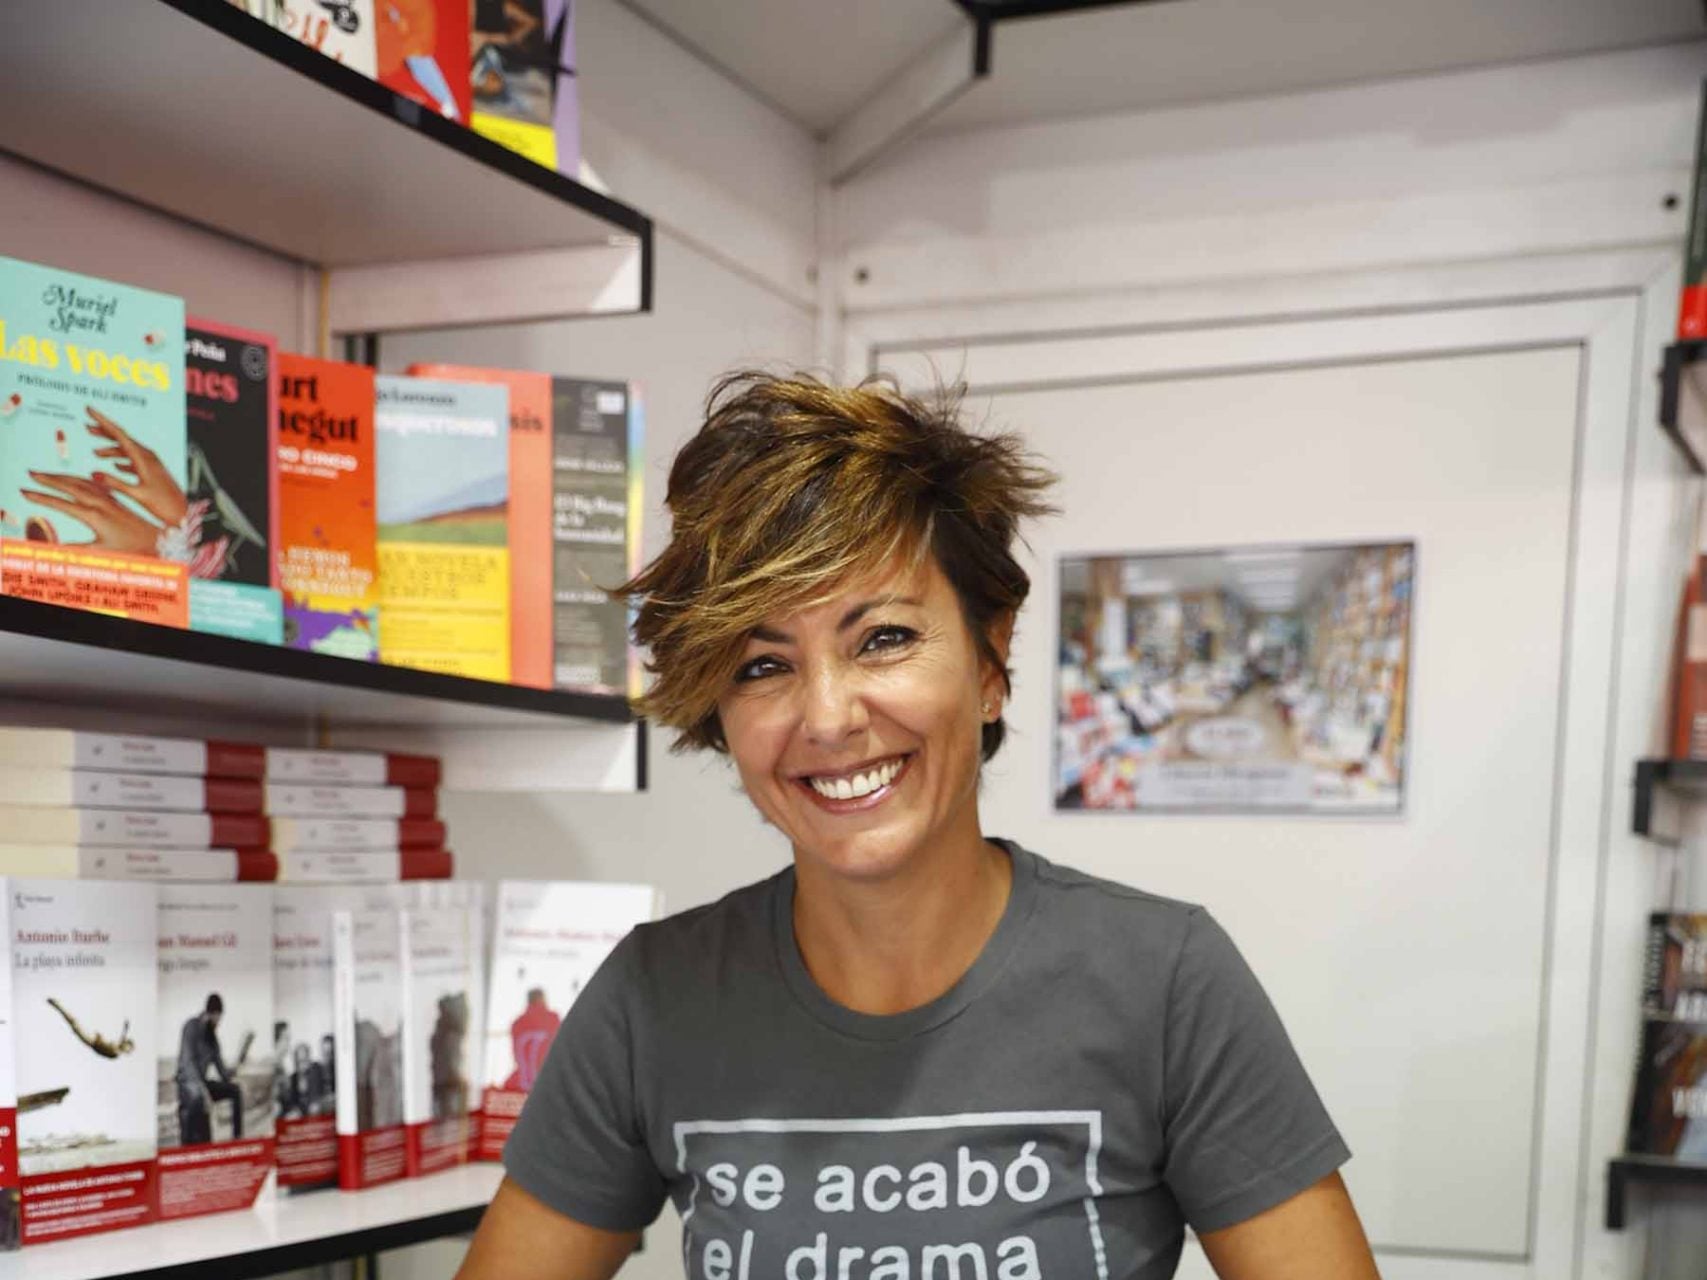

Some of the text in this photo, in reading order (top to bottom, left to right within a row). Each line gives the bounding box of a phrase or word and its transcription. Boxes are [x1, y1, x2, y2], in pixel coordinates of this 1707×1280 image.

[42, 284, 118, 317] Muriel
[50, 306, 107, 334] Spark
[0, 319, 170, 393] Las voces
[705, 1140, 1051, 1214] se acabó
